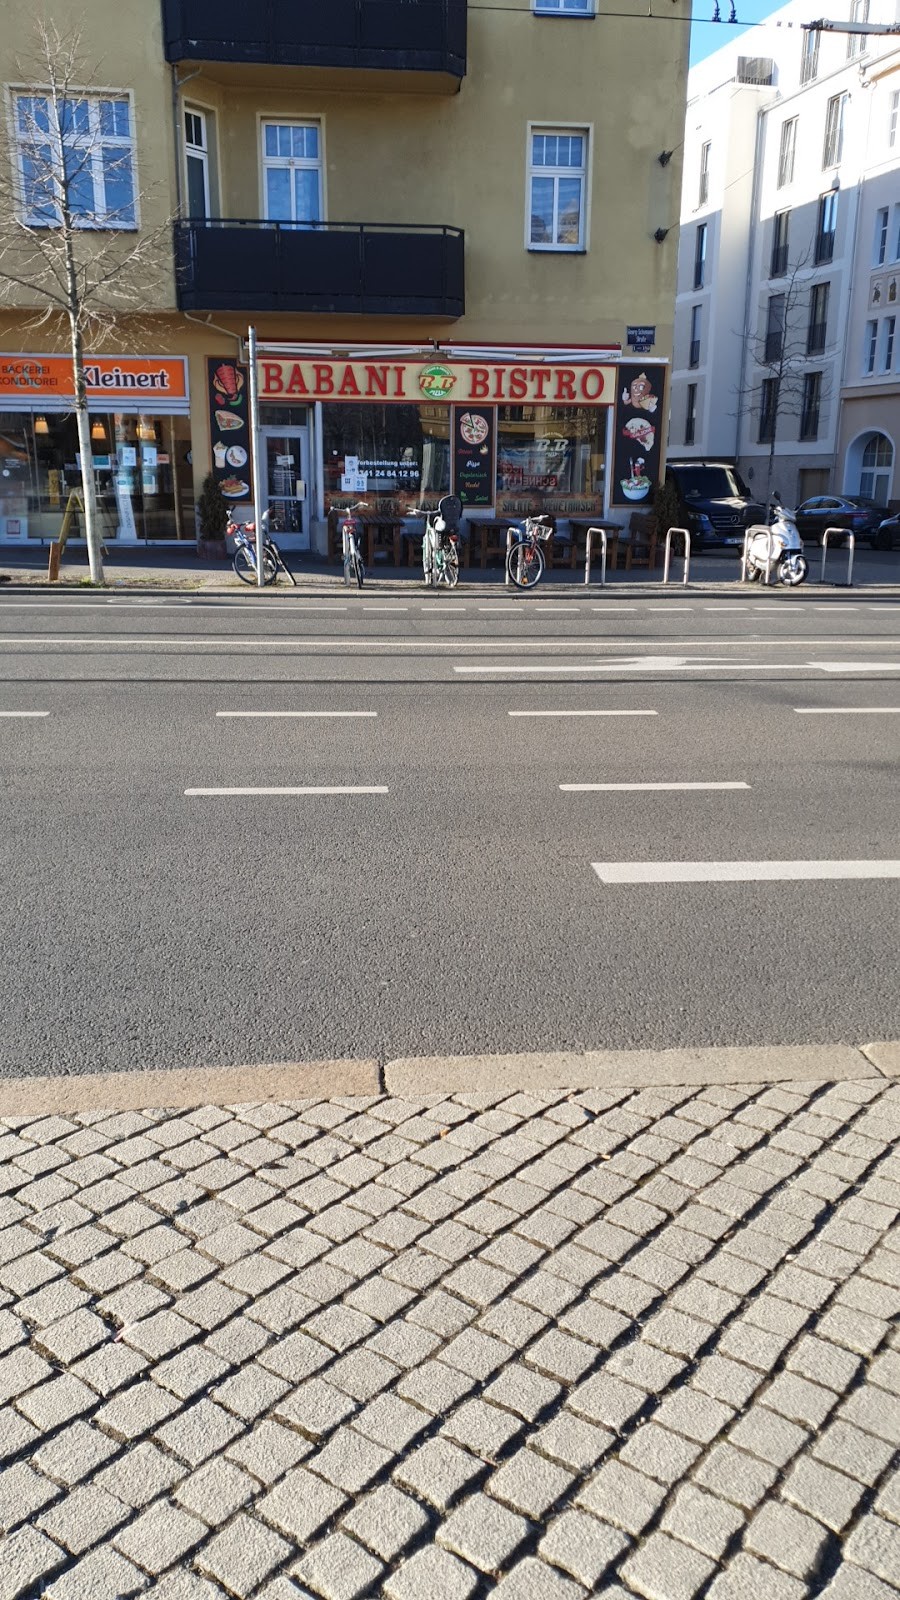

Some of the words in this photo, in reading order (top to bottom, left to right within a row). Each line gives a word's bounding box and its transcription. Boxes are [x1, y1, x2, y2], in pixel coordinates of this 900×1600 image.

[82, 367, 169, 388] Kleinert
[262, 363, 406, 397] BABANI
[468, 368, 605, 400] BISTRO
